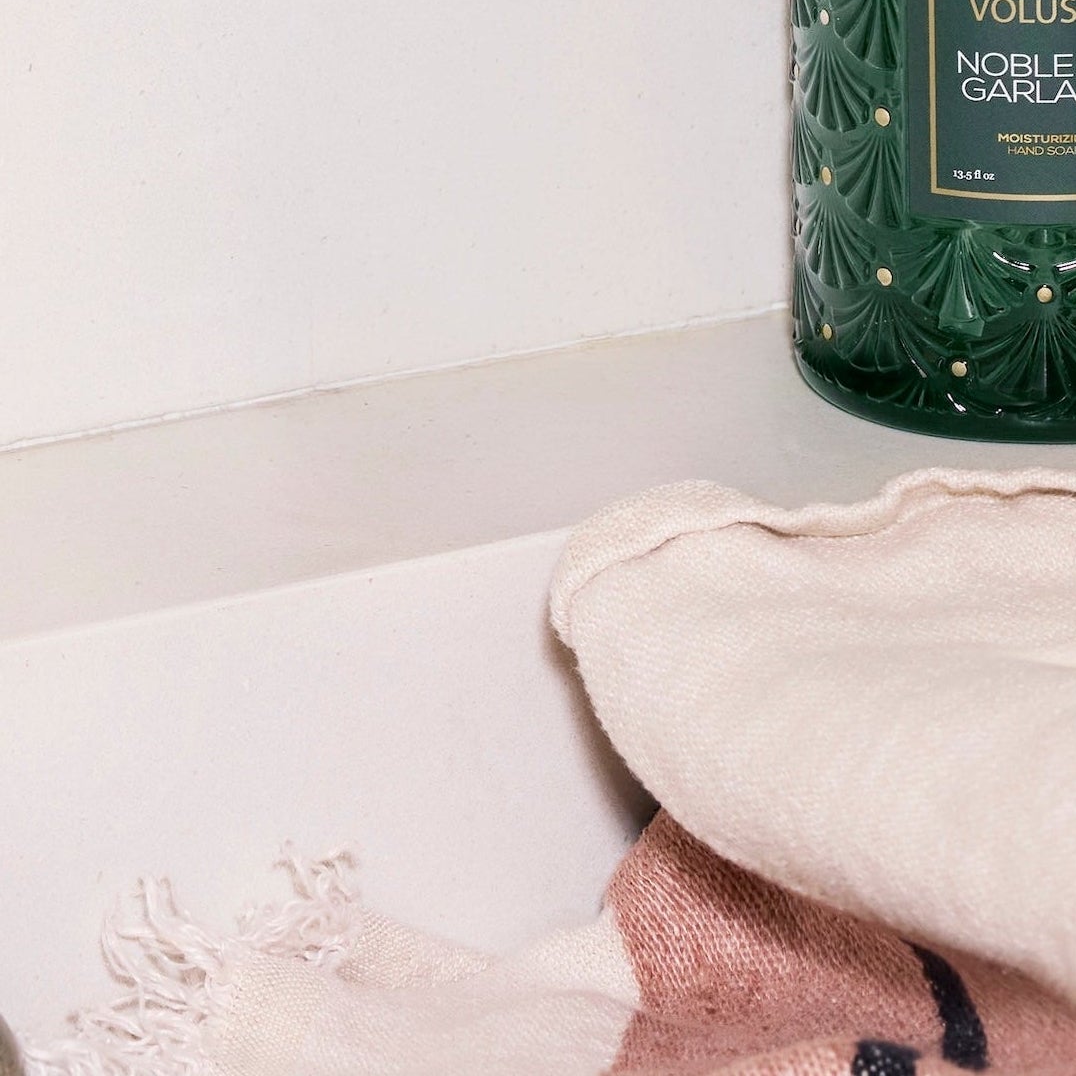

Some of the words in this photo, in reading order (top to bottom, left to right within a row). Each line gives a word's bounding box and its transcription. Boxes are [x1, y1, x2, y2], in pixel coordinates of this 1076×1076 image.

[957, 50, 1074, 78] NOBLE
[1007, 145, 1044, 156] HAND
[952, 169, 973, 180] 13.5
[974, 169, 982, 180] fl
[983, 171, 995, 181] oz
